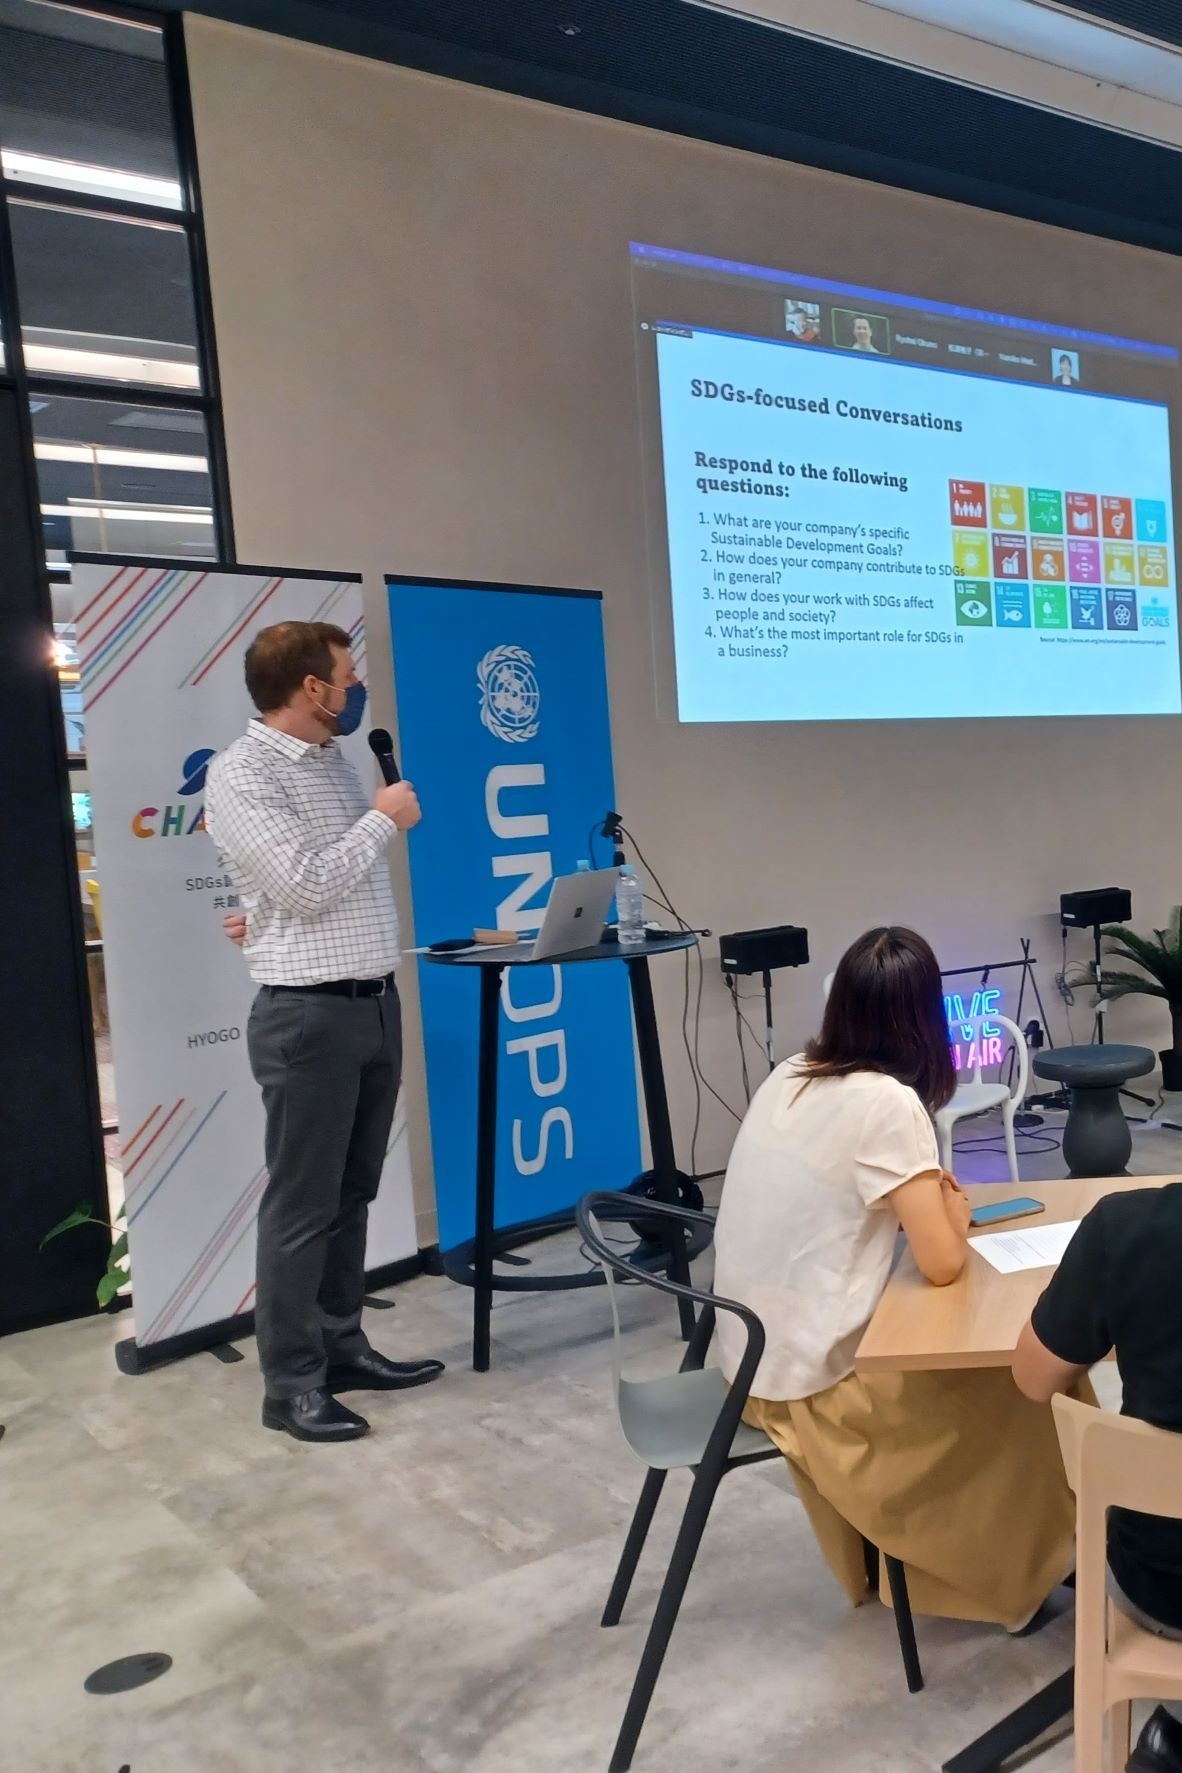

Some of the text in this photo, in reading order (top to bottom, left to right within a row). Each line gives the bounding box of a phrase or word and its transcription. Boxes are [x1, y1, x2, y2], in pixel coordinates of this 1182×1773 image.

[690, 379, 963, 432] SDGs-focused Conversations
[694, 451, 908, 492] Respond to the following
[696, 477, 790, 497] questions:
[698, 511, 910, 540] 1. What are your company’s specific
[711, 531, 903, 556] Sustainable Development Goals?
[700, 549, 965, 576] 2. How does your company contribute to SDGs
[713, 568, 781, 584] in general?
[702, 587, 934, 609] 3. How does your work with SDGs affect
[715, 607, 836, 624] people and society?
[704, 625, 964, 643] 4. What’s the most important role for SDGs in
[718, 643, 788, 657] a business?
[187, 1027, 241, 1048] HYOGO
